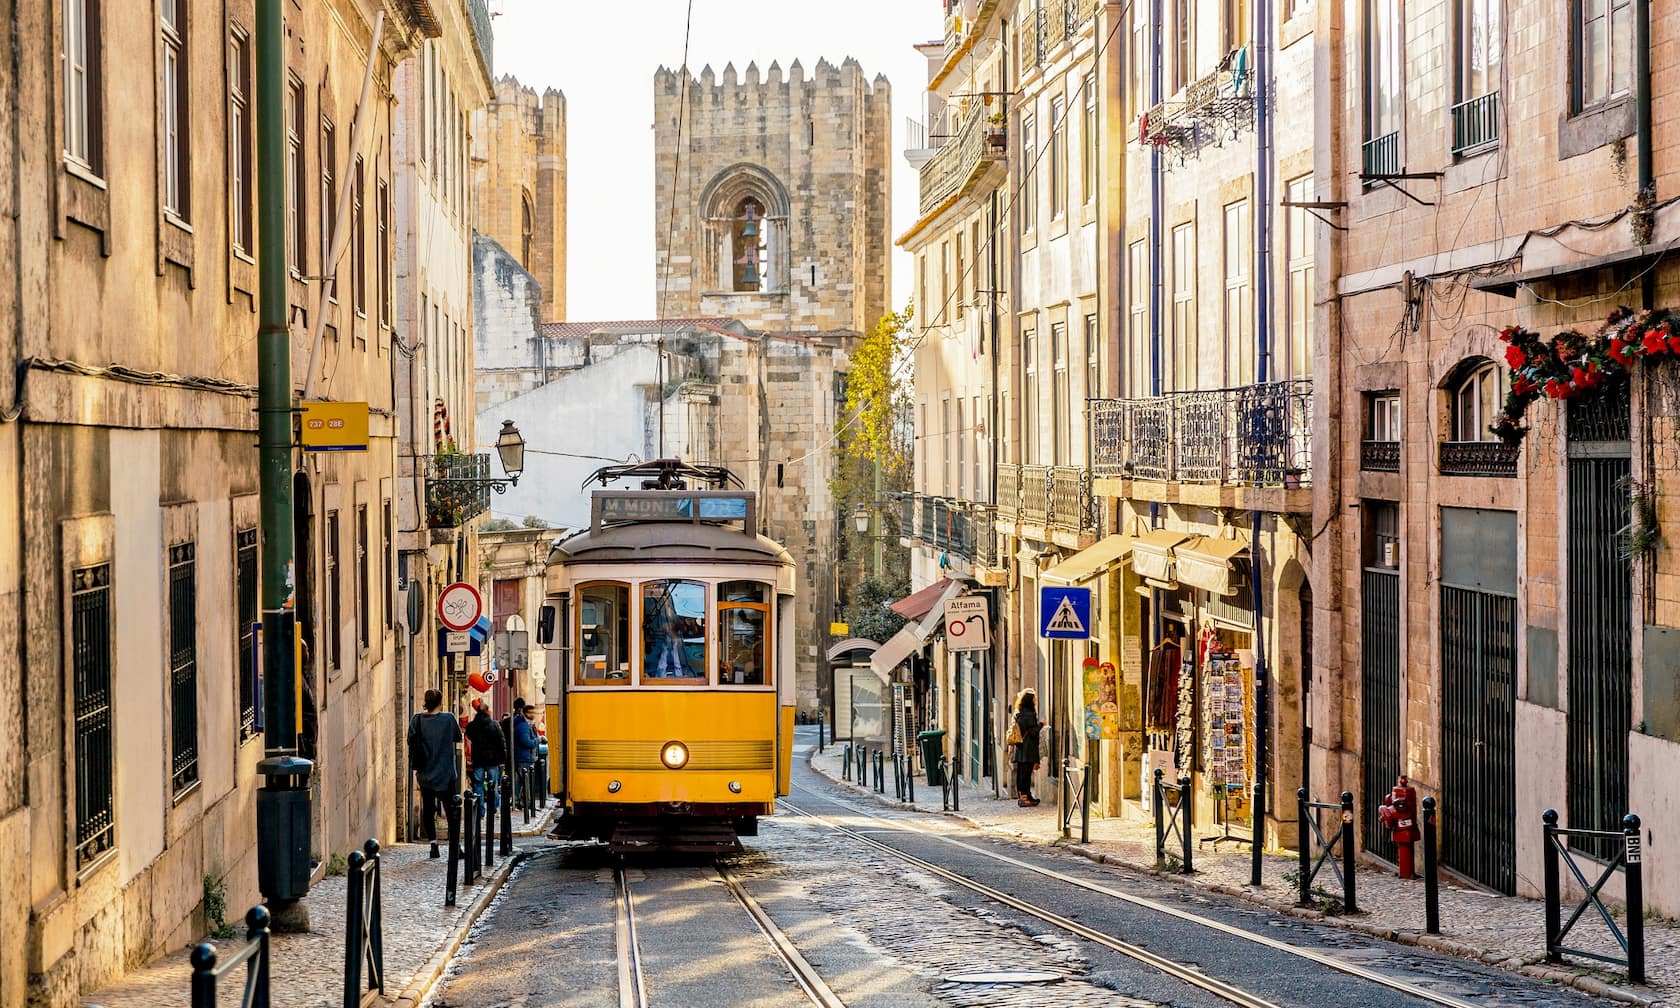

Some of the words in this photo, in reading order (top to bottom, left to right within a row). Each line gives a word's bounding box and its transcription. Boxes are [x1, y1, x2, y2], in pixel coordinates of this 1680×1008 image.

[309, 420, 323, 428] 737
[950, 601, 981, 609] Alfama
[1626, 836, 1640, 863] BNE
